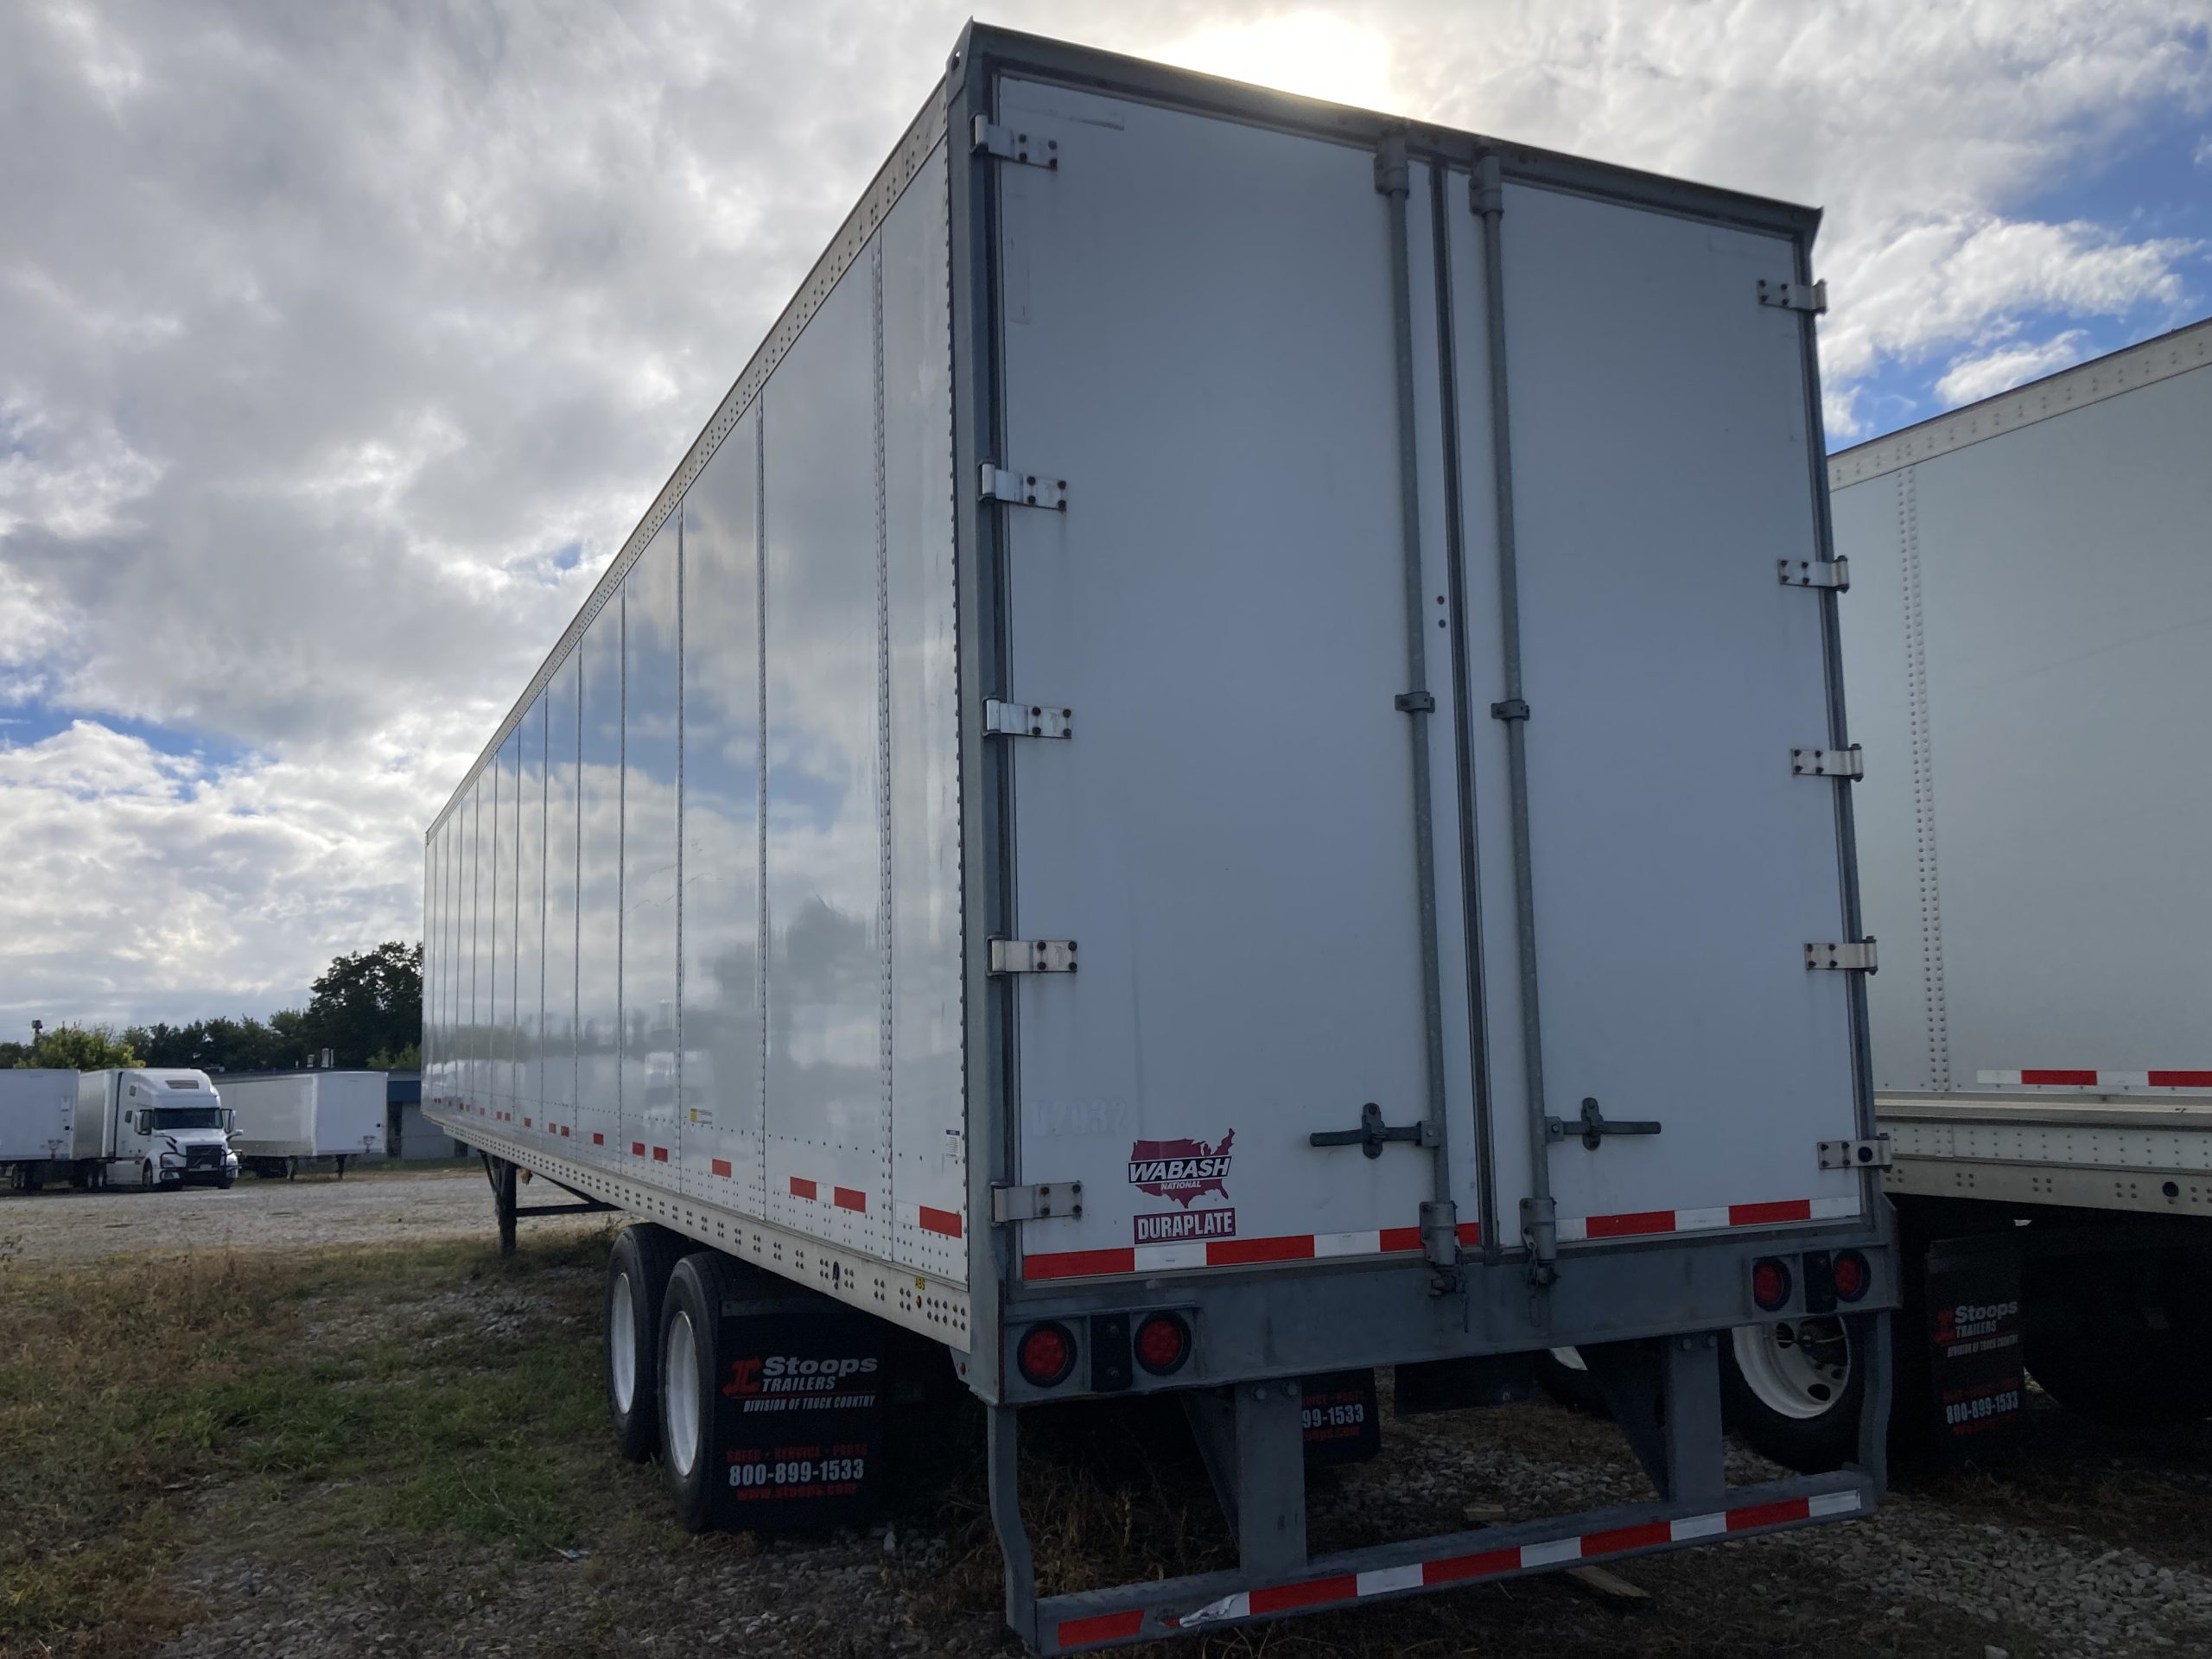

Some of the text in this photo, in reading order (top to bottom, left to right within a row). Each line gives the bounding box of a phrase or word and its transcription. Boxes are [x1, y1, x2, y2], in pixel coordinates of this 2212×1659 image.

[1130, 1158, 1231, 1182] WABASH
[1160, 1180, 1202, 1191] NATIONAL
[1138, 1212, 1232, 1240] DURAPLATE
[915, 1277, 925, 1291] ABS
[1955, 1301, 2018, 1324] Stoops
[1956, 1320, 1997, 1338] TRAILERS
[762, 1356, 878, 1376] Stoops
[762, 1376, 836, 1393] TRAILERS
[743, 1395, 875, 1412] DIVISION OF TRUCK COUNTRY
[1946, 1390, 2018, 1424] 800-899-1533
[729, 1459, 864, 1486] 800-899-1533
